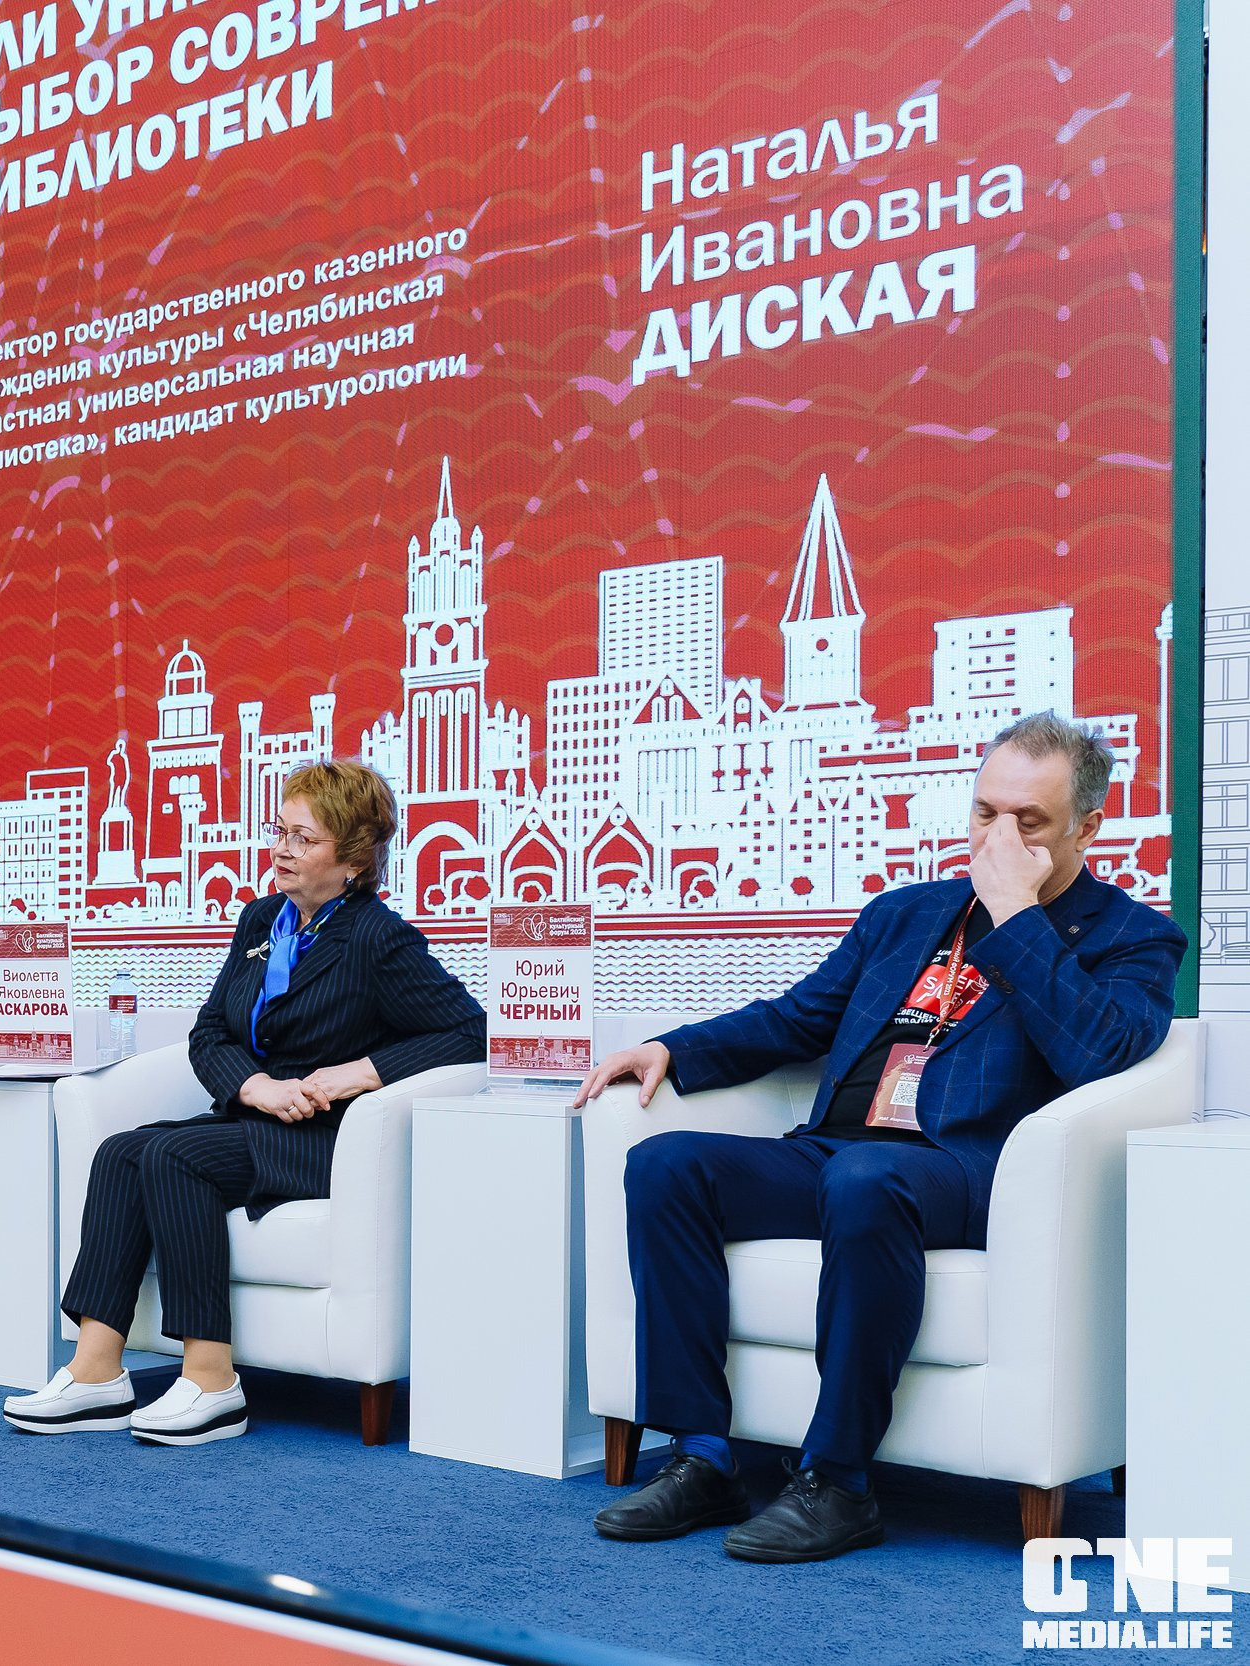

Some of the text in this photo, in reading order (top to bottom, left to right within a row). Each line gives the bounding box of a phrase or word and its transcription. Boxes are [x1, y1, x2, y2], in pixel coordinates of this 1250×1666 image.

[641, 93, 940, 212] Наталья
[640, 163, 1025, 293] Ивановна
[64, 268, 306, 345] государственного
[314, 227, 468, 285] казенного
[99, 326, 225, 378] культуры
[233, 273, 445, 342] «Челябинская
[632, 244, 978, 387] ДИСКАЯ
[77, 352, 284, 423] универсальная
[293, 322, 415, 372] научная
[114, 401, 238, 446] кандидат
[245, 353, 468, 424] культурологии
[3, 969, 59, 982] Виолетта
[499, 1000, 581, 1021] ЧЕРНЫЙ
[501, 982, 580, 1001] Юрьевич
[516, 959, 565, 980] Юрий
